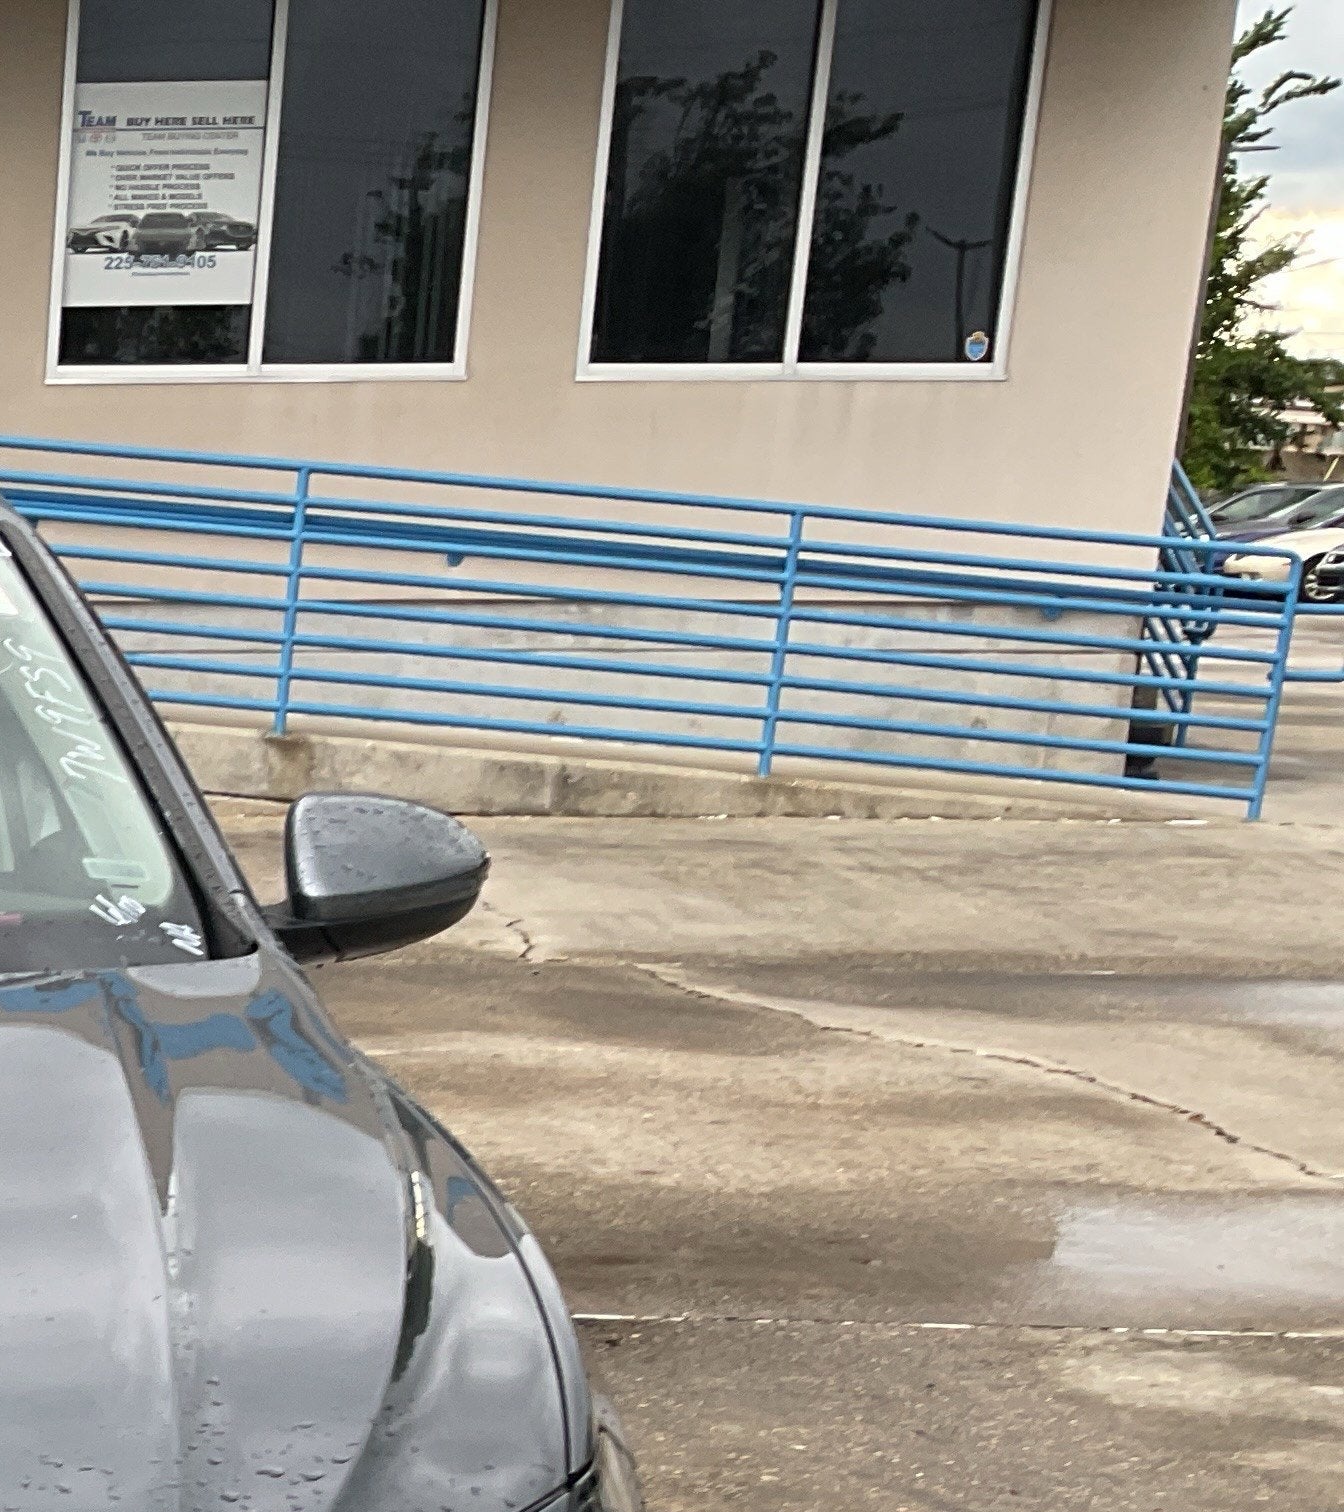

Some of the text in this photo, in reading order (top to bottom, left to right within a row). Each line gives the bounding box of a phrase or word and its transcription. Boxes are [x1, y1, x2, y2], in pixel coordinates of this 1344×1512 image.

[78, 110, 116, 127] TEAM
[126, 115, 255, 127] BUY HERE SELL HERE
